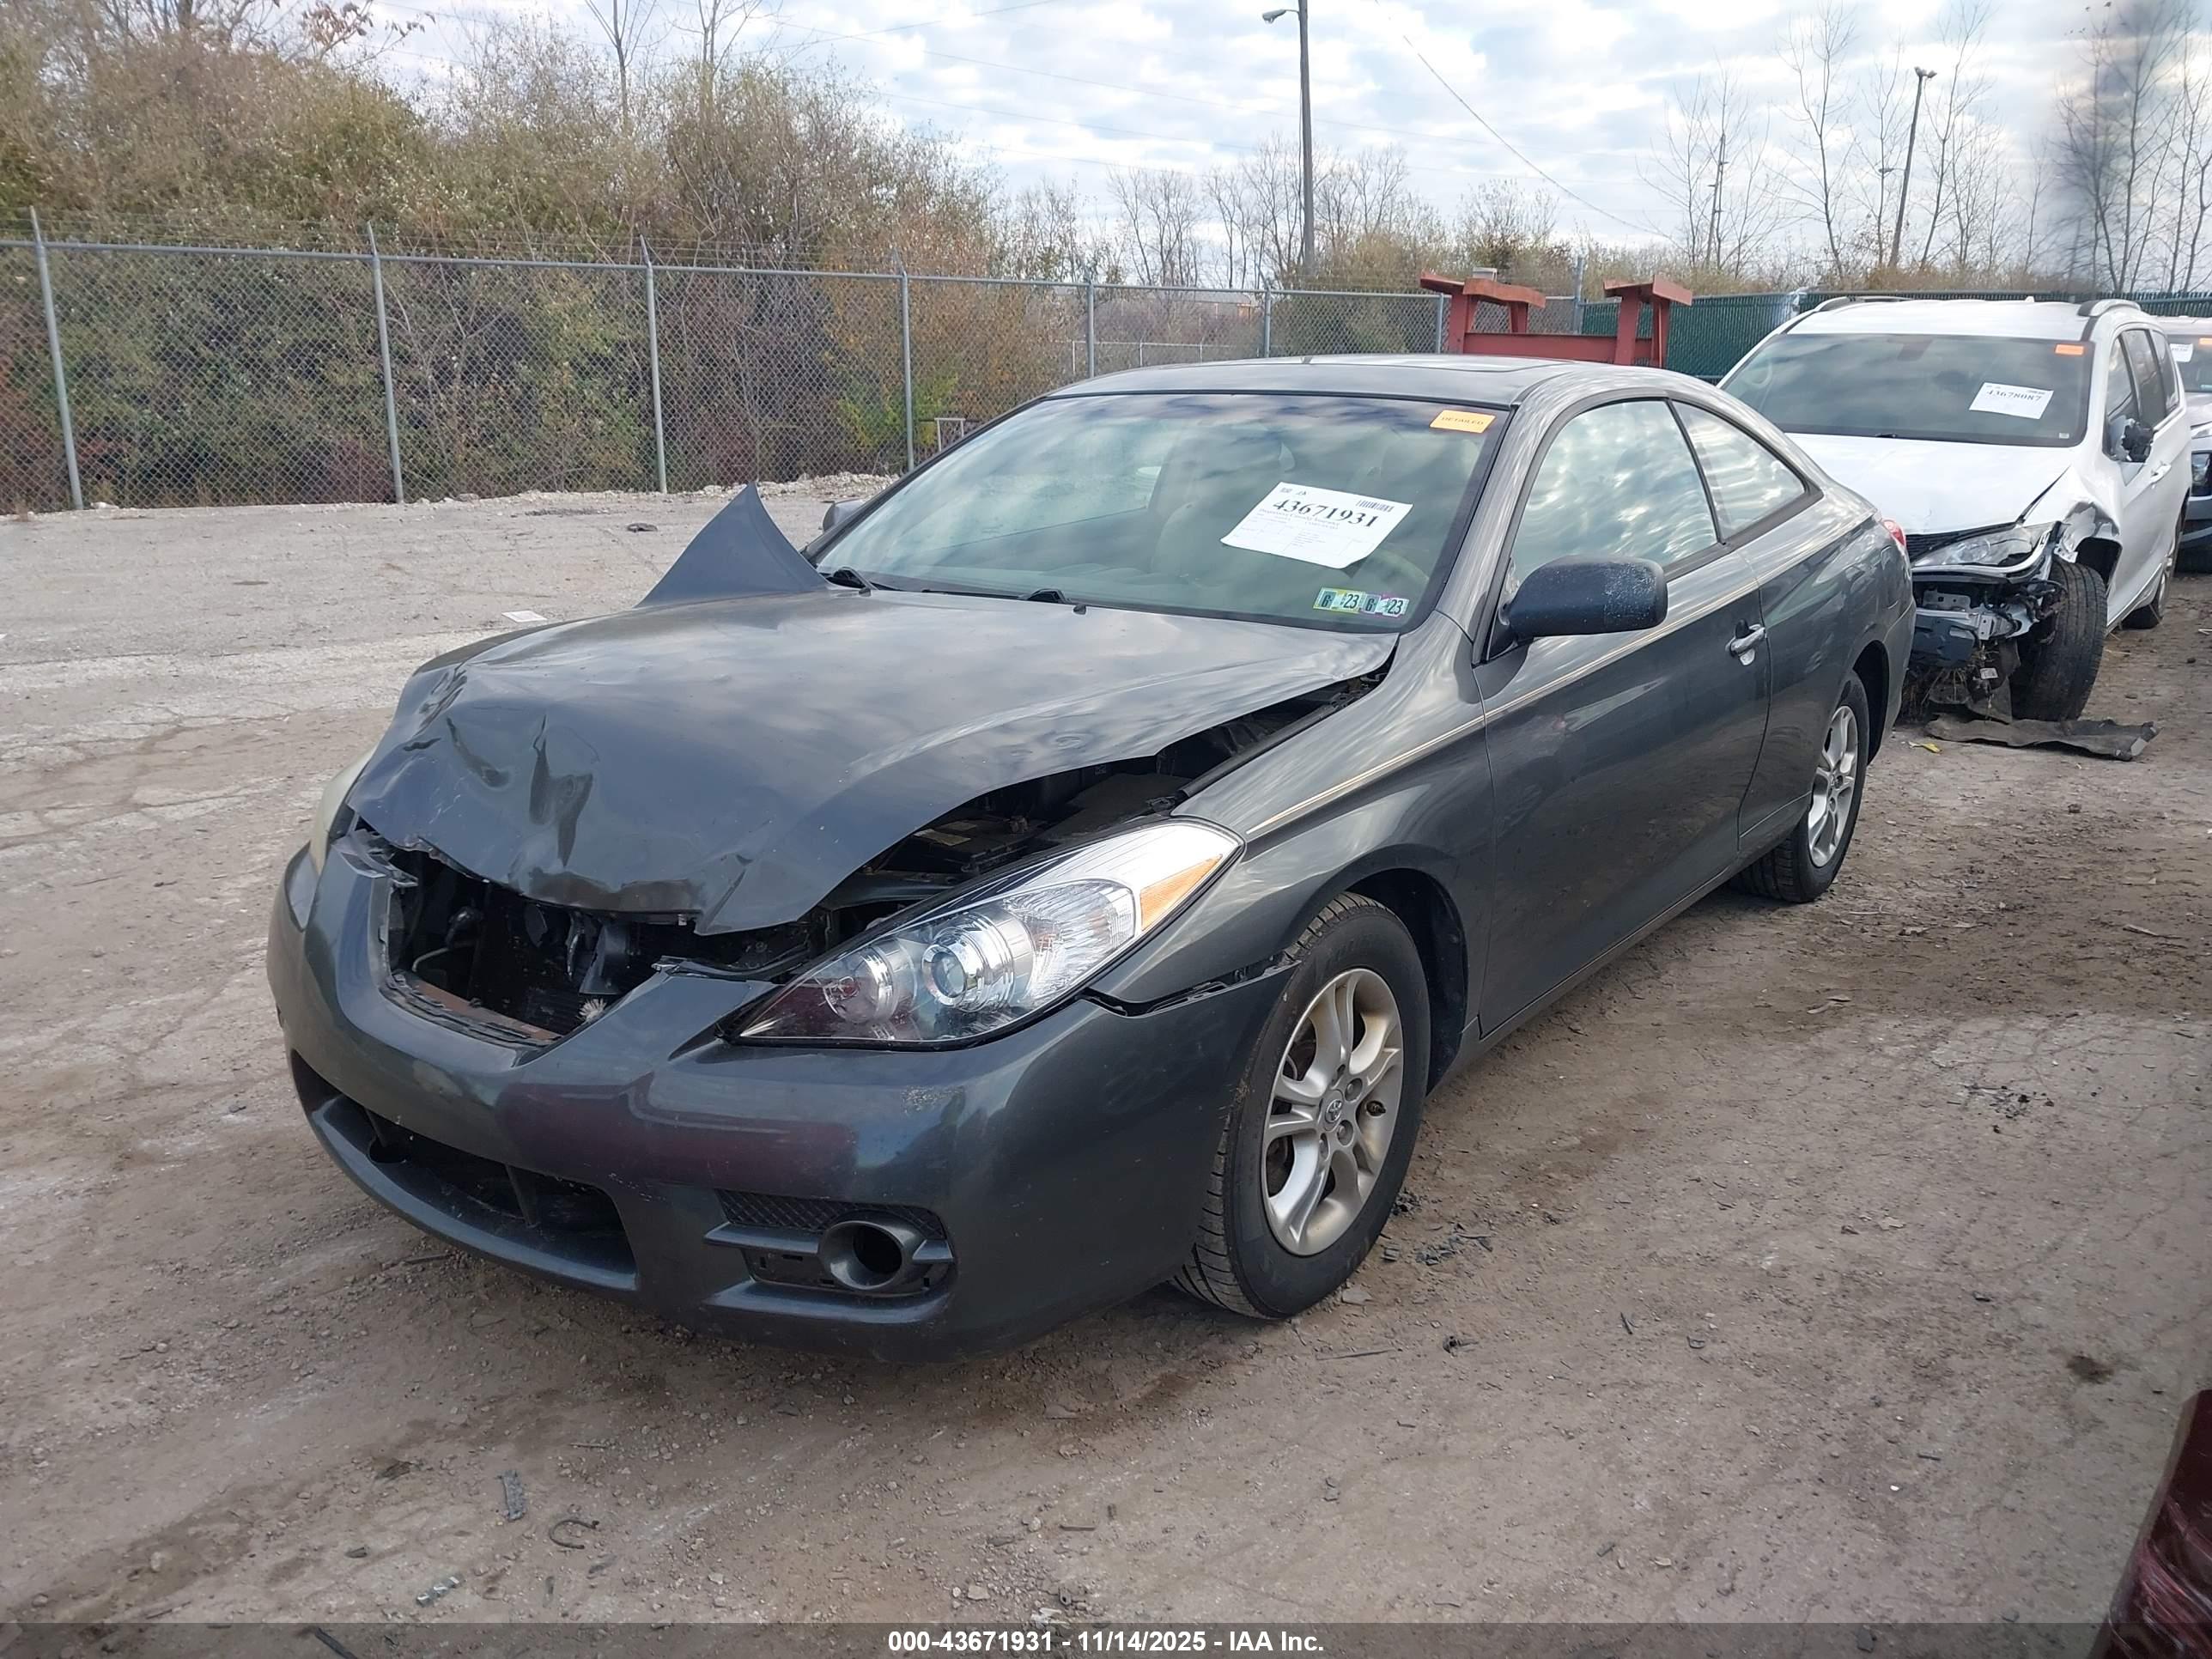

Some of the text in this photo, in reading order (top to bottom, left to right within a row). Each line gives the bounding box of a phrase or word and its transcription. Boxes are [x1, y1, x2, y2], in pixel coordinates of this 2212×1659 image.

[1273, 498, 1379, 528] 43671931
[1343, 593, 1360, 610] 23
[1387, 599, 1404, 615] 23
